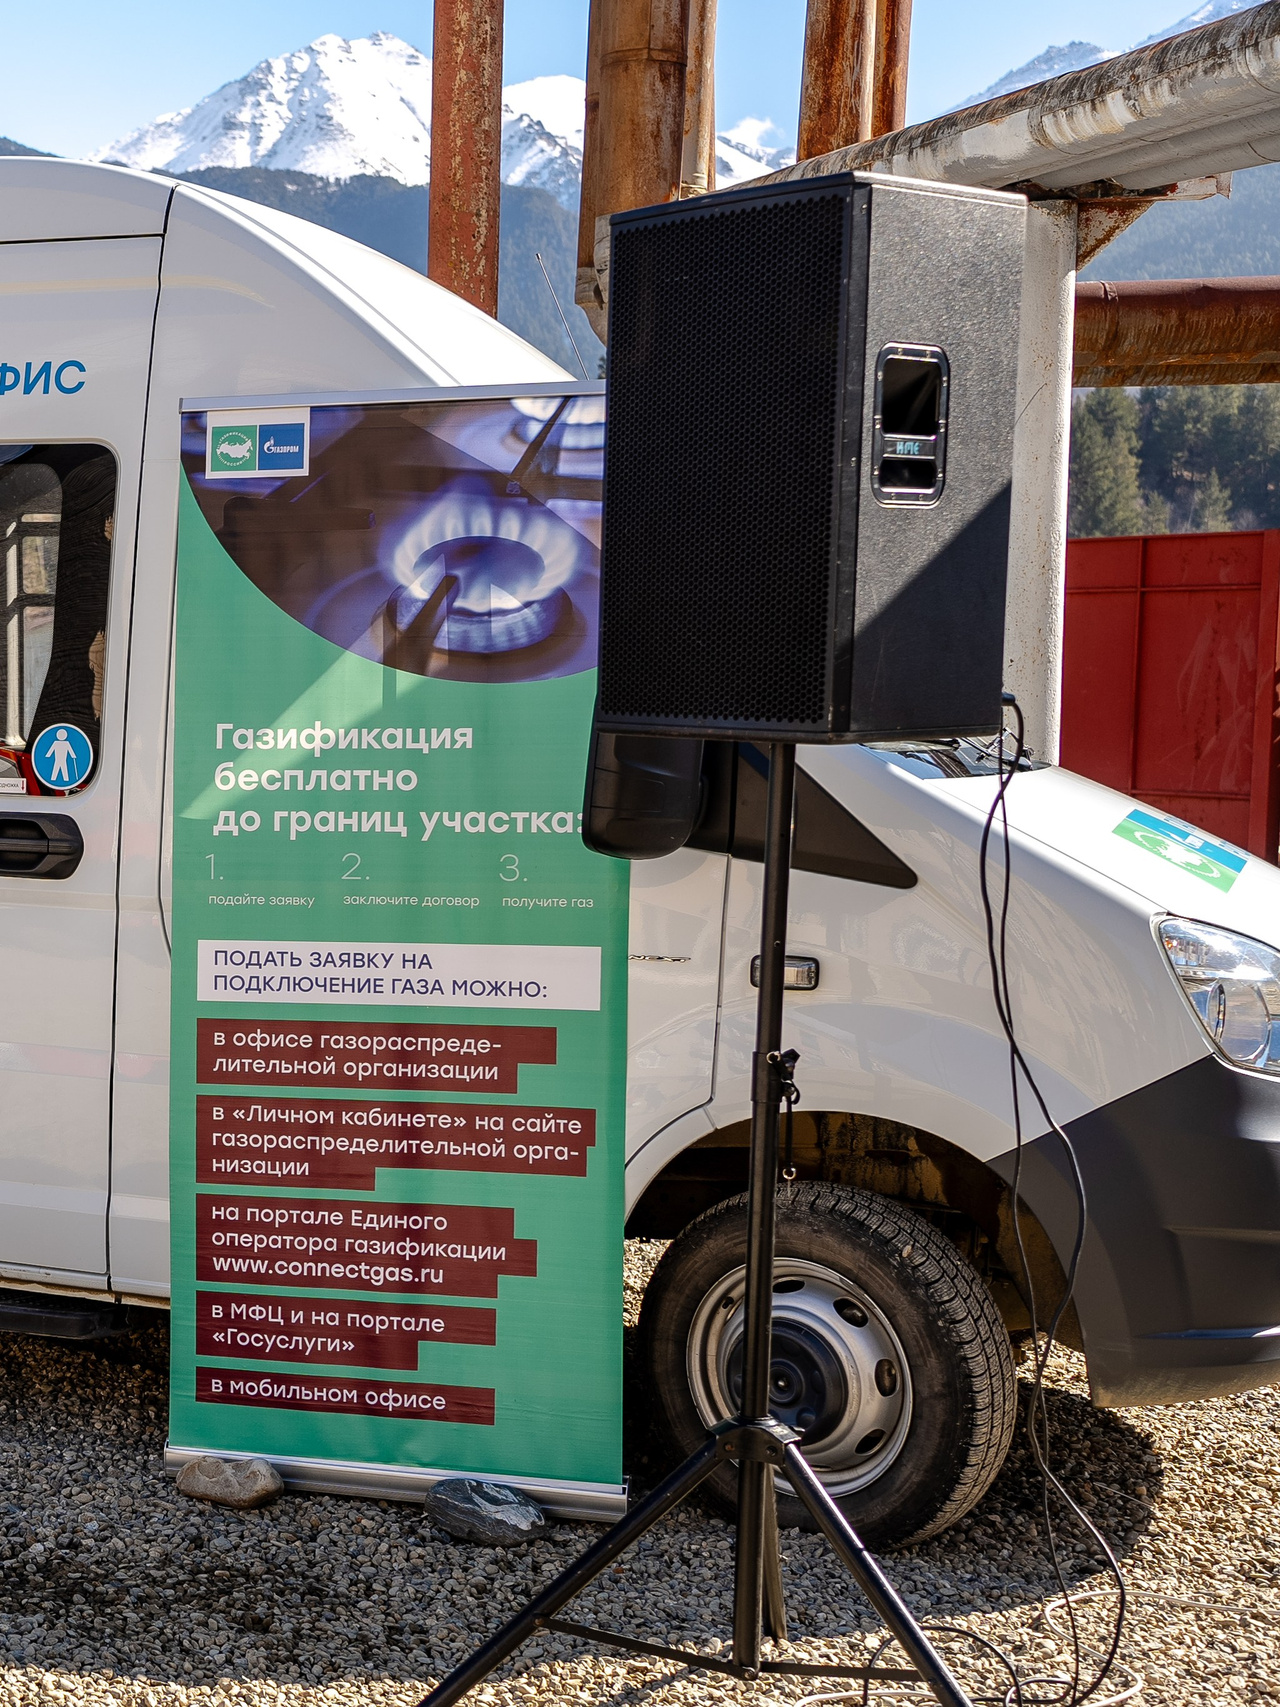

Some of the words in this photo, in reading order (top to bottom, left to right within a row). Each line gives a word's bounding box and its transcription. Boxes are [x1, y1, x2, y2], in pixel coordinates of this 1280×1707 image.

[215, 721, 474, 756] Газификация
[213, 762, 418, 791] бесплатно
[213, 810, 261, 837] до
[274, 812, 408, 840] границ
[205, 853, 224, 881] 1.
[341, 853, 370, 881] 2.
[499, 854, 528, 882] 3.
[209, 894, 265, 908] подайте
[269, 895, 315, 908] заявку
[343, 894, 418, 906] заключите
[422, 896, 480, 909] договор
[502, 897, 567, 910] получите
[571, 898, 594, 908] газ
[213, 950, 302, 970] ПОДАТЬ
[309, 951, 394, 970] ЗАЯВКУ
[402, 954, 433, 971] НА
[213, 974, 385, 995] ПОДКЛЮЧЕНИЕ
[391, 978, 444, 996] ГАЗА
[452, 979, 547, 999] МОЖНО:
[214, 1034, 225, 1046] в
[233, 1029, 313, 1050] офисе
[320, 1033, 502, 1055] газораспреде-
[213, 1055, 335, 1076] лительной
[343, 1062, 499, 1082] организации
[213, 1107, 224, 1120] в
[232, 1105, 334, 1125] «Личном
[342, 1109, 467, 1130] кабинете»
[475, 1116, 504, 1130] на
[511, 1114, 582, 1135] сайте
[212, 1132, 506, 1159] газораспределительной
[513, 1145, 579, 1164] орга-
[212, 1159, 310, 1177] низации
[212, 1206, 239, 1221] на
[246, 1208, 343, 1228] портале
[350, 1210, 448, 1232] Единого
[212, 1232, 337, 1255] оператора
[345, 1238, 506, 1262] газификации
[213, 1256, 444, 1286] www.connectgas.ru
[212, 1305, 223, 1319] в
[231, 1304, 284, 1326] МФЦ
[292, 1311, 303, 1324] и
[311, 1311, 339, 1326] на
[347, 1312, 445, 1334] портале
[213, 1329, 356, 1355] «Госуслуги»
[211, 1379, 223, 1393] в
[230, 1379, 357, 1403] мобильном
[365, 1388, 446, 1412] офисе
